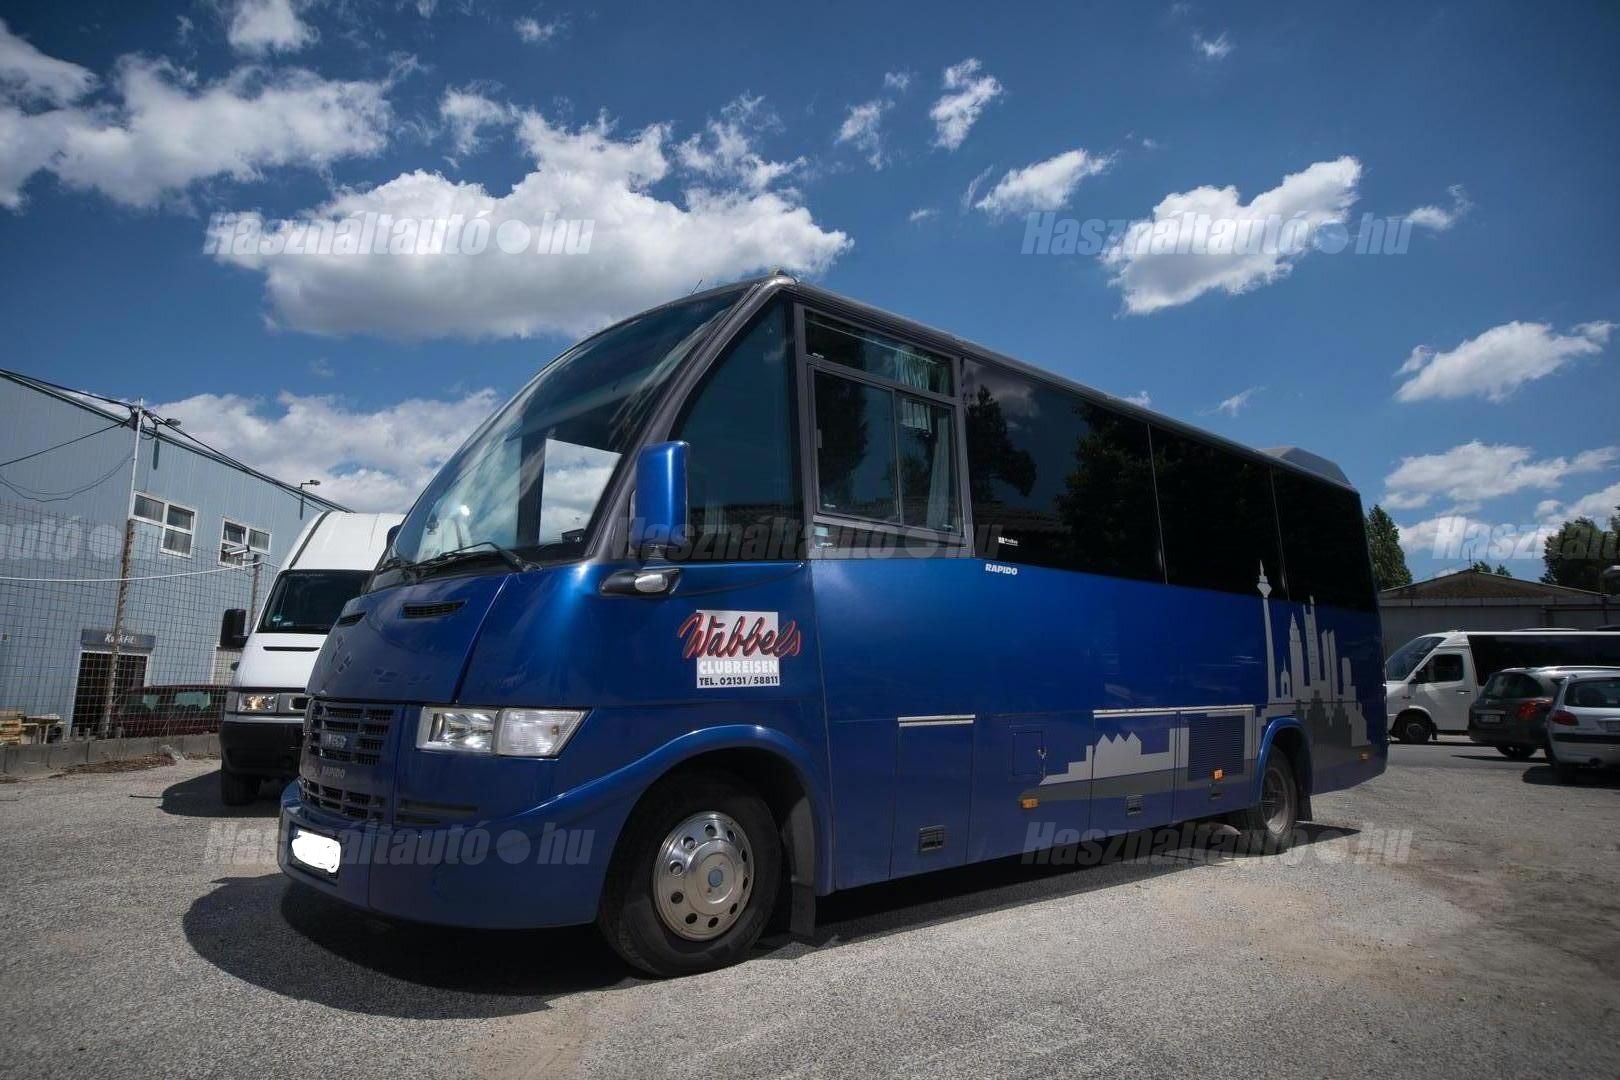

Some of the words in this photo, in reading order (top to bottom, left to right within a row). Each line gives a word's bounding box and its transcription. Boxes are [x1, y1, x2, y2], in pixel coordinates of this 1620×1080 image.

[985, 563, 1018, 576] RAPIDO
[699, 660, 778, 675] CLUBREISEN
[699, 677, 718, 686] TEL.
